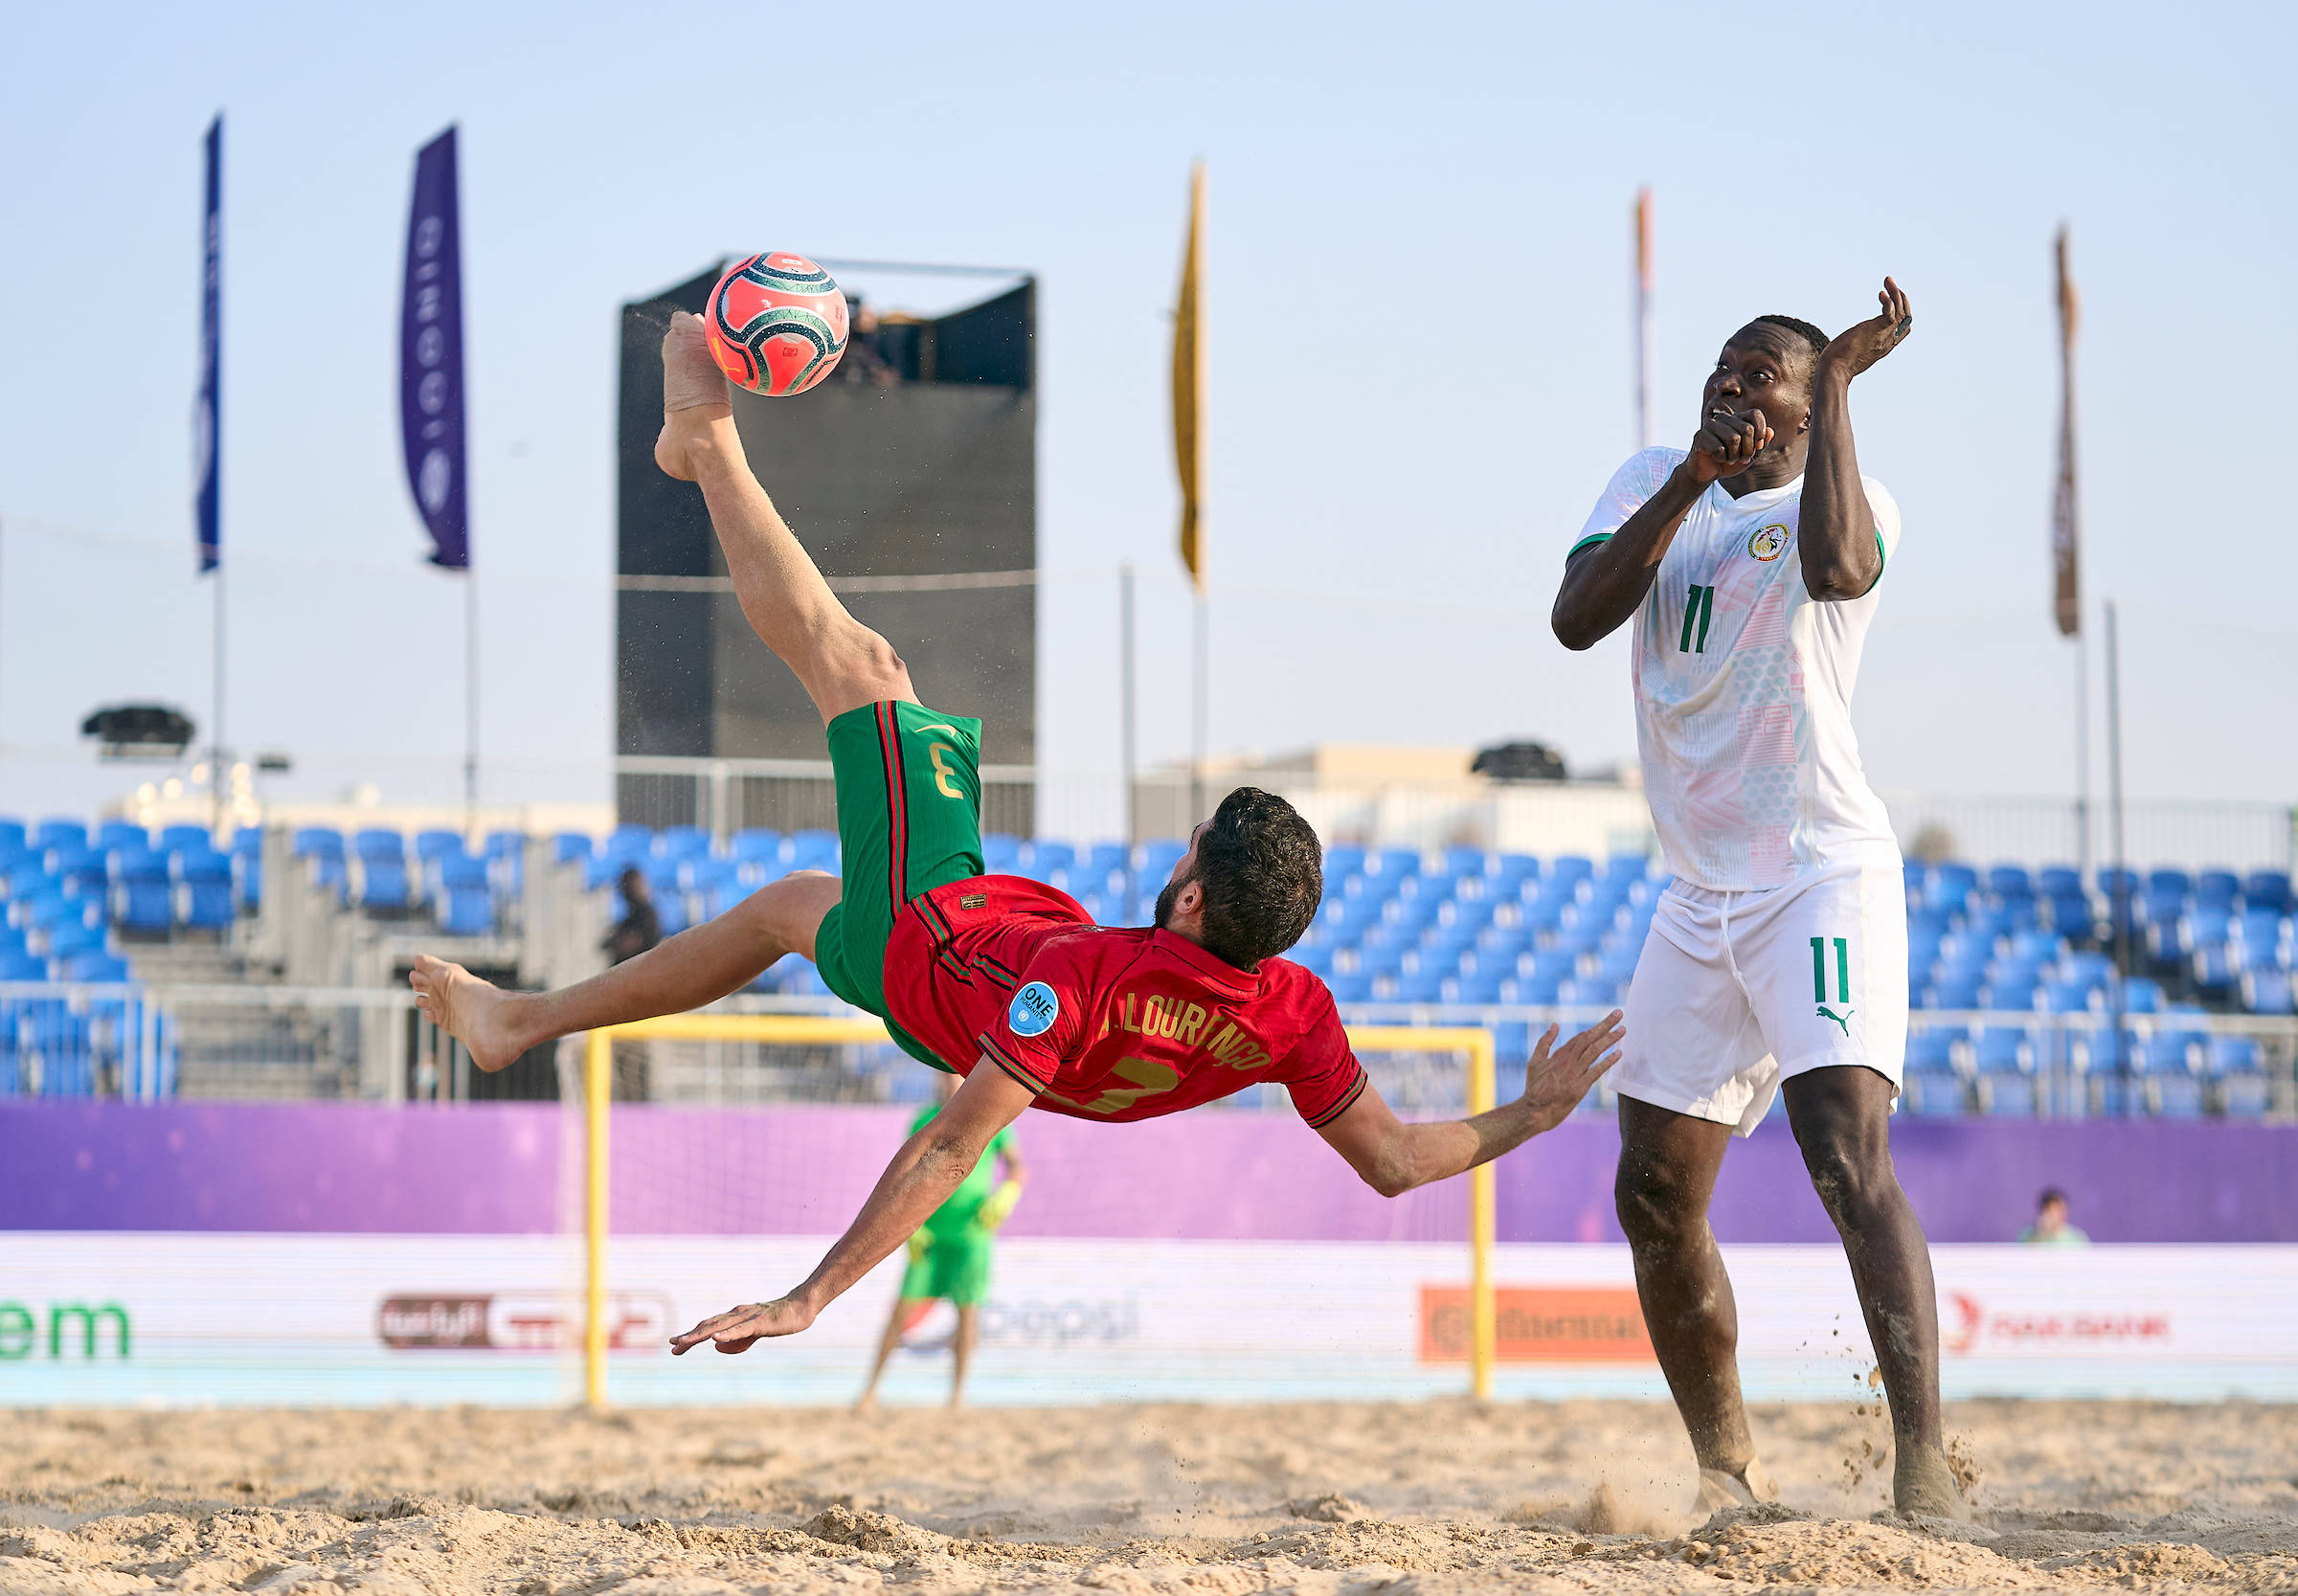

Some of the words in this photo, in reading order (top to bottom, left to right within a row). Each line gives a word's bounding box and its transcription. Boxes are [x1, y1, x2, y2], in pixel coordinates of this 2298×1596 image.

[1679, 584, 1715, 653] 11
[929, 742, 963, 799] 3
[1811, 937, 1849, 1003] 11
[1020, 997, 1045, 1021] HUMANITY
[1025, 988, 1054, 1017] ONE
